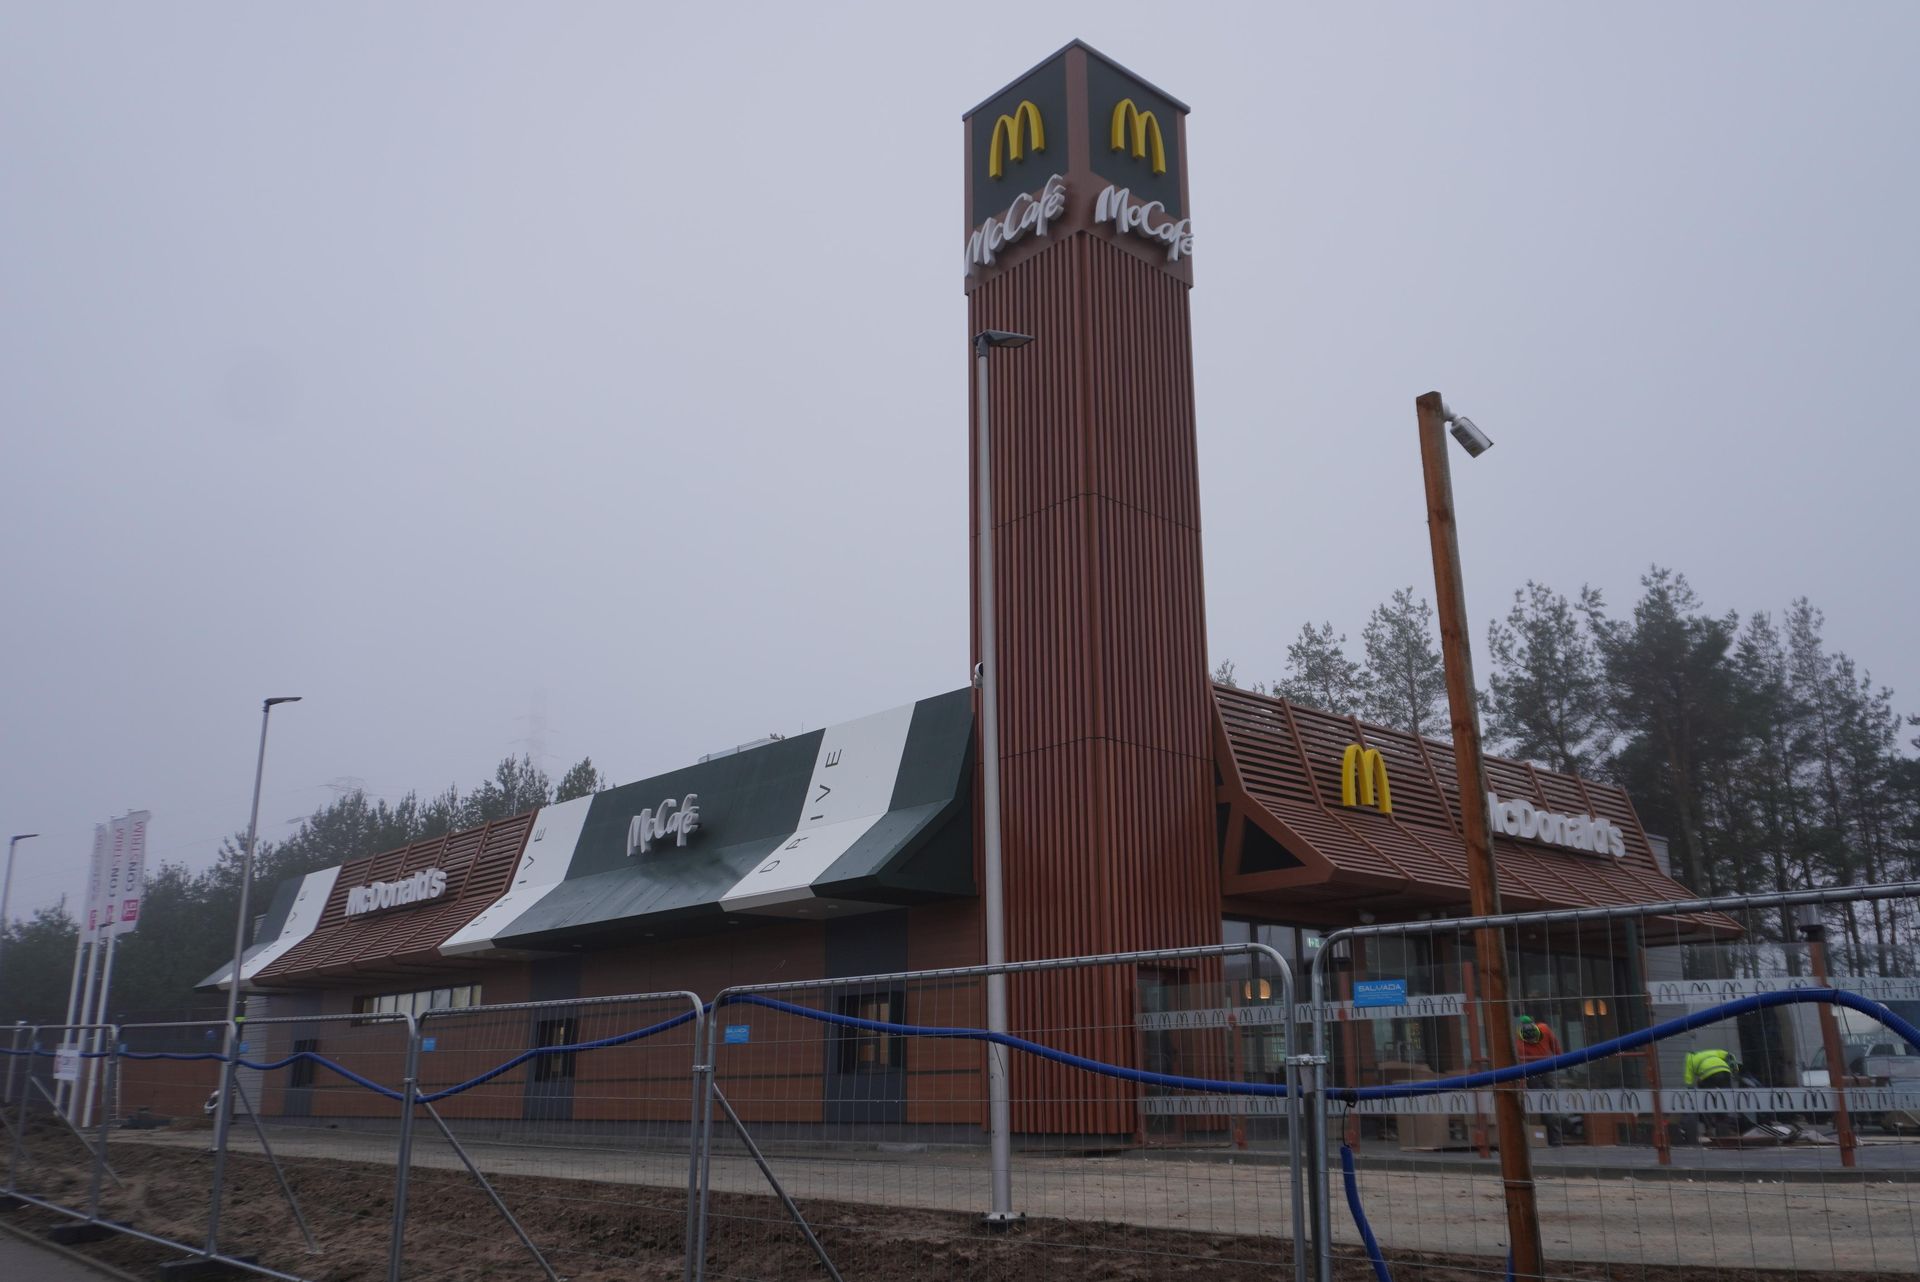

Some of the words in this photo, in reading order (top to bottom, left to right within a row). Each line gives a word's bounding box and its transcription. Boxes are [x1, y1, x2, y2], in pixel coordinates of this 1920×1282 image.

[965, 174, 1066, 277] McCafé
[1095, 185, 1194, 261] McCafé
[626, 793, 700, 857] McCafé
[759, 749, 843, 874] DRIVE
[345, 868, 448, 916] McDonald's
